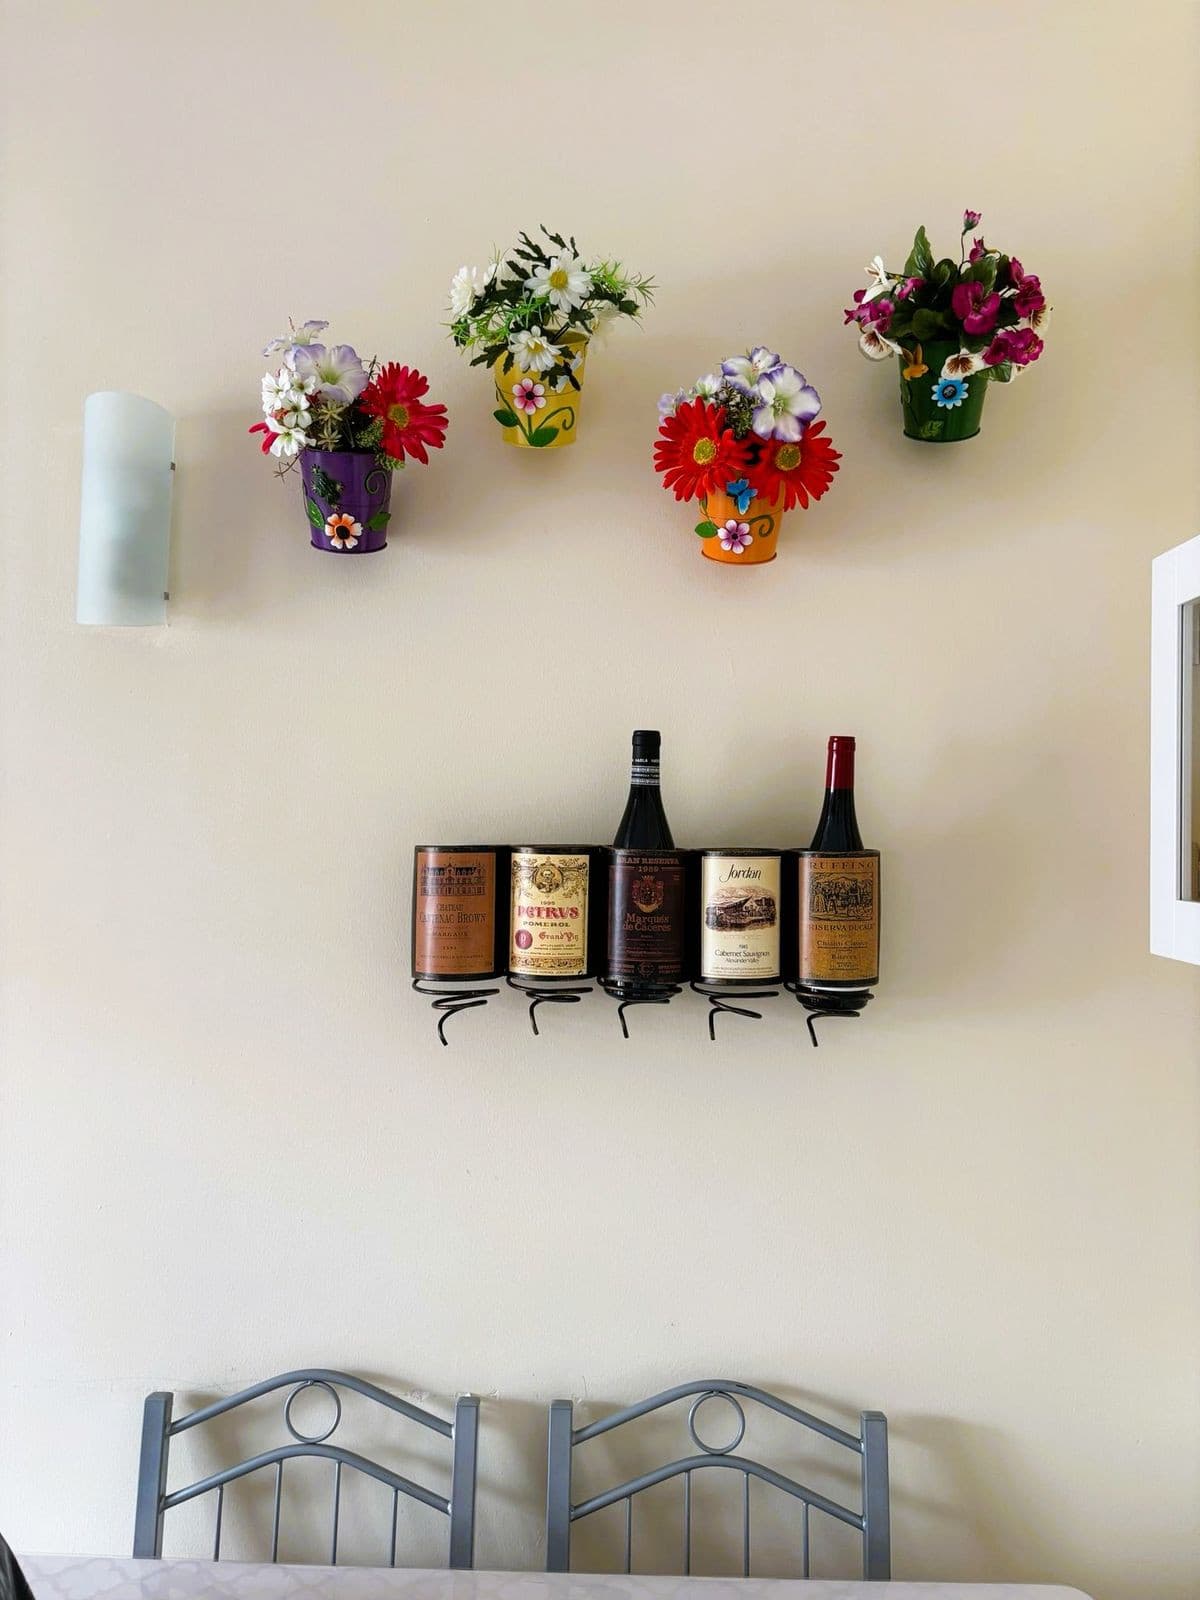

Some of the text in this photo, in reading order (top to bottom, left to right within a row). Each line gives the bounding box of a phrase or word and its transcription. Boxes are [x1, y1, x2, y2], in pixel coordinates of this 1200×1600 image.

[641, 857, 680, 865] RESERVA
[810, 861, 874, 870] RUFFINO
[718, 864, 762, 882] Jordan
[457, 912, 488, 924] BROWN
